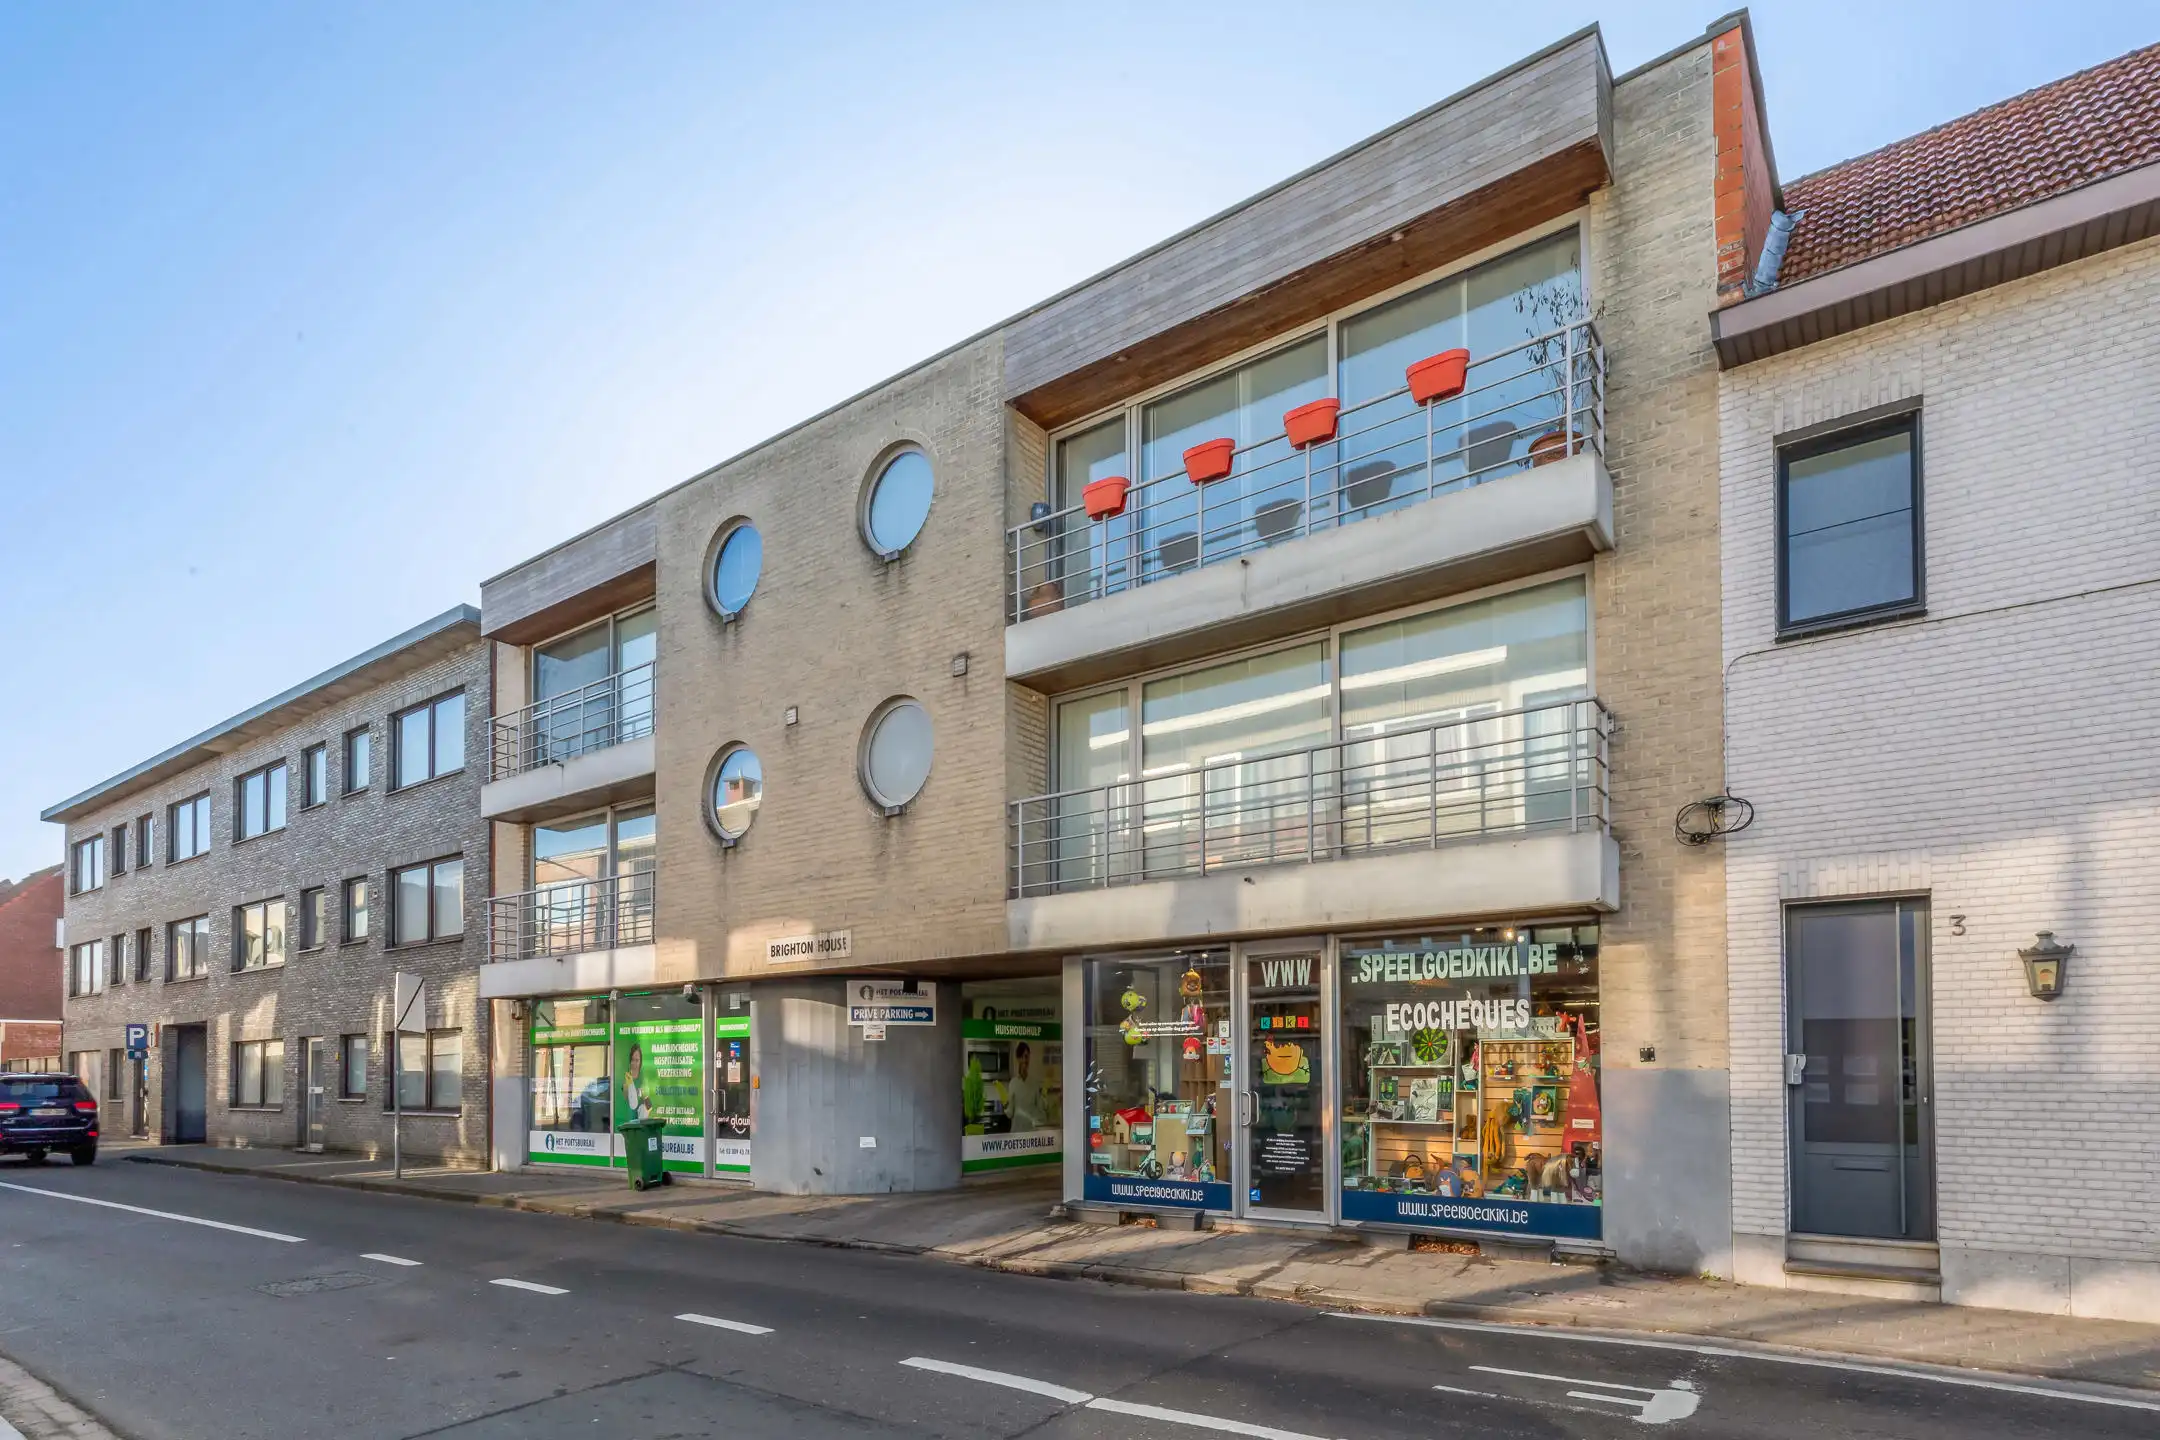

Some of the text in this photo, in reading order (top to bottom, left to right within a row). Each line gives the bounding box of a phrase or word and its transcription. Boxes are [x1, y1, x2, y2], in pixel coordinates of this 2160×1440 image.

[1950, 914, 1966, 936] 3
[770, 937, 847, 957] BRIGHTON HOUSE
[1351, 943, 1558, 983] .SPEELGOEDKIKI.BE
[1261, 959, 1312, 988] WWW
[880, 1008, 914, 1019] PARKING
[1386, 999, 1529, 1032] ECOCHEQUES
[129, 1027, 145, 1046] P
[995, 1024, 1042, 1036] HUISHOUDHULP
[657, 1068, 692, 1077] VERZEKERING
[555, 1138, 596, 1148] HET POETSBUREAU
[662, 1142, 694, 1155] BUREAU.BE
[981, 1136, 1055, 1153] WWW.POETSBUREAU.BE
[1397, 1201, 1529, 1224] www.speelgoedkiki.be
